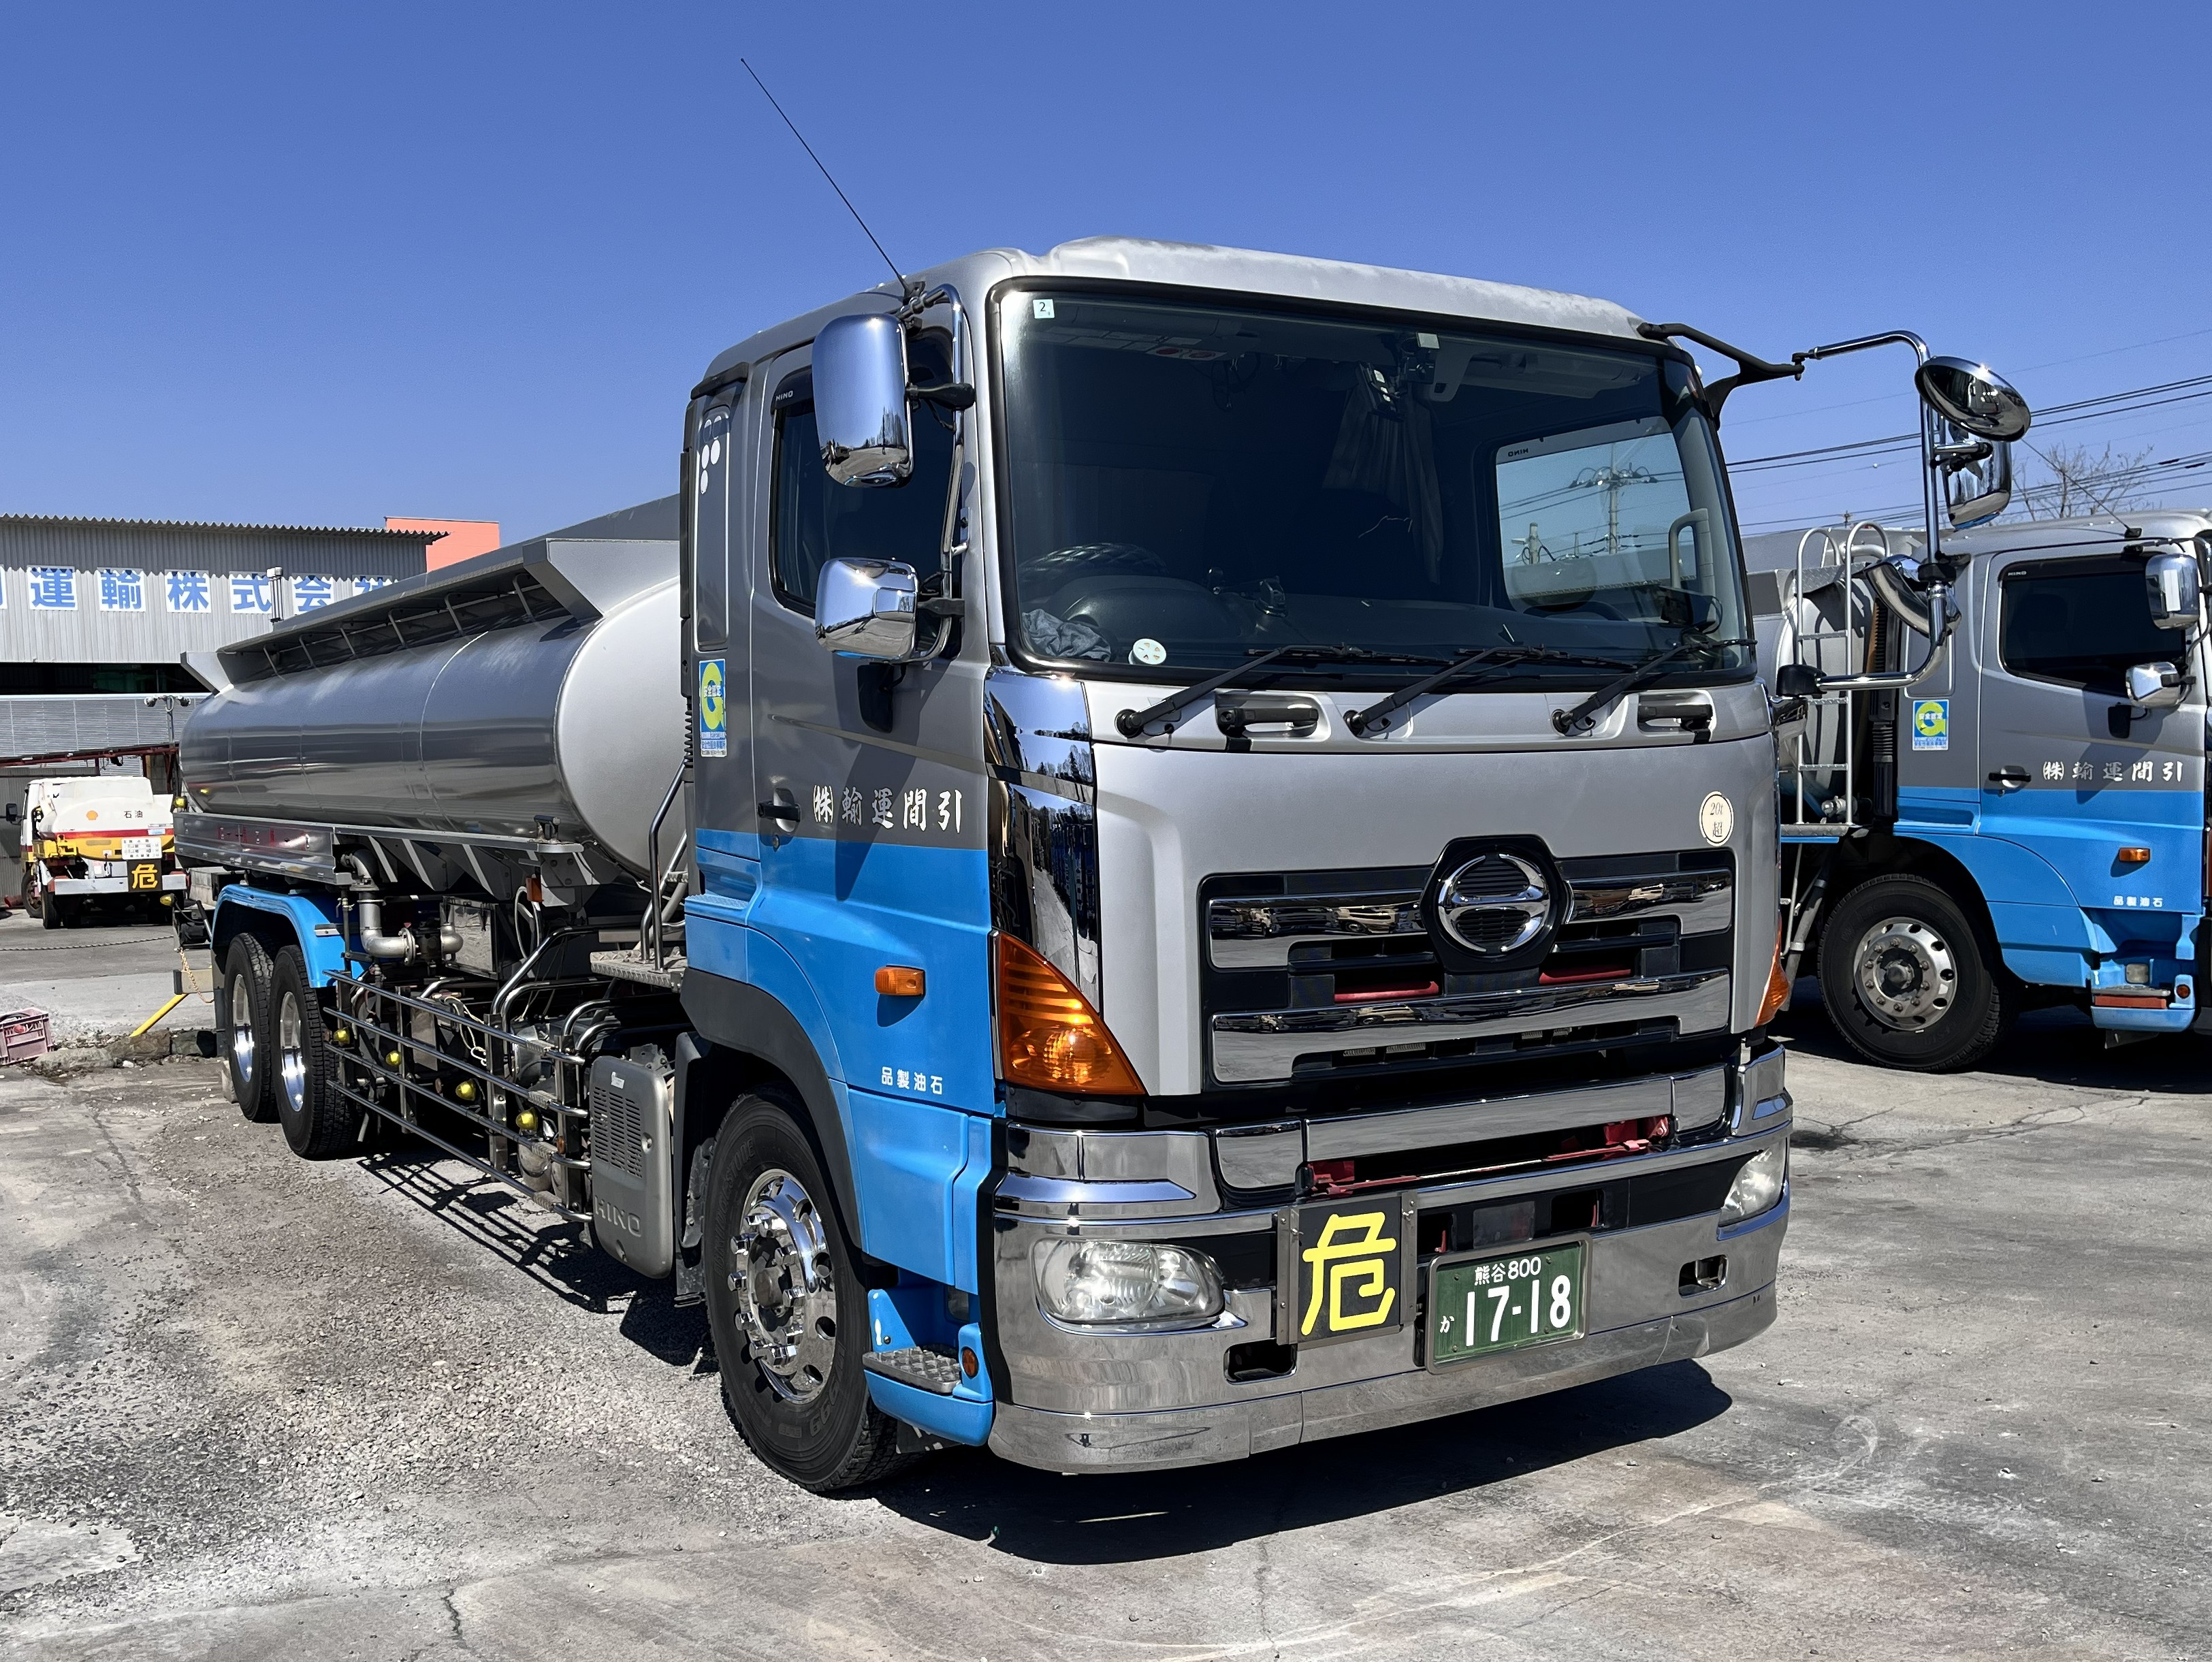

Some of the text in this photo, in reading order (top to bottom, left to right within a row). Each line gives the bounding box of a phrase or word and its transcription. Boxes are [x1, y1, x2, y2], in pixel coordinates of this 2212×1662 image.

[1039, 302, 1046, 312] 2
[131, 863, 158, 889] 危
[1301, 1211, 1397, 1336] 危
[1465, 1274, 1571, 1347] 17-18
